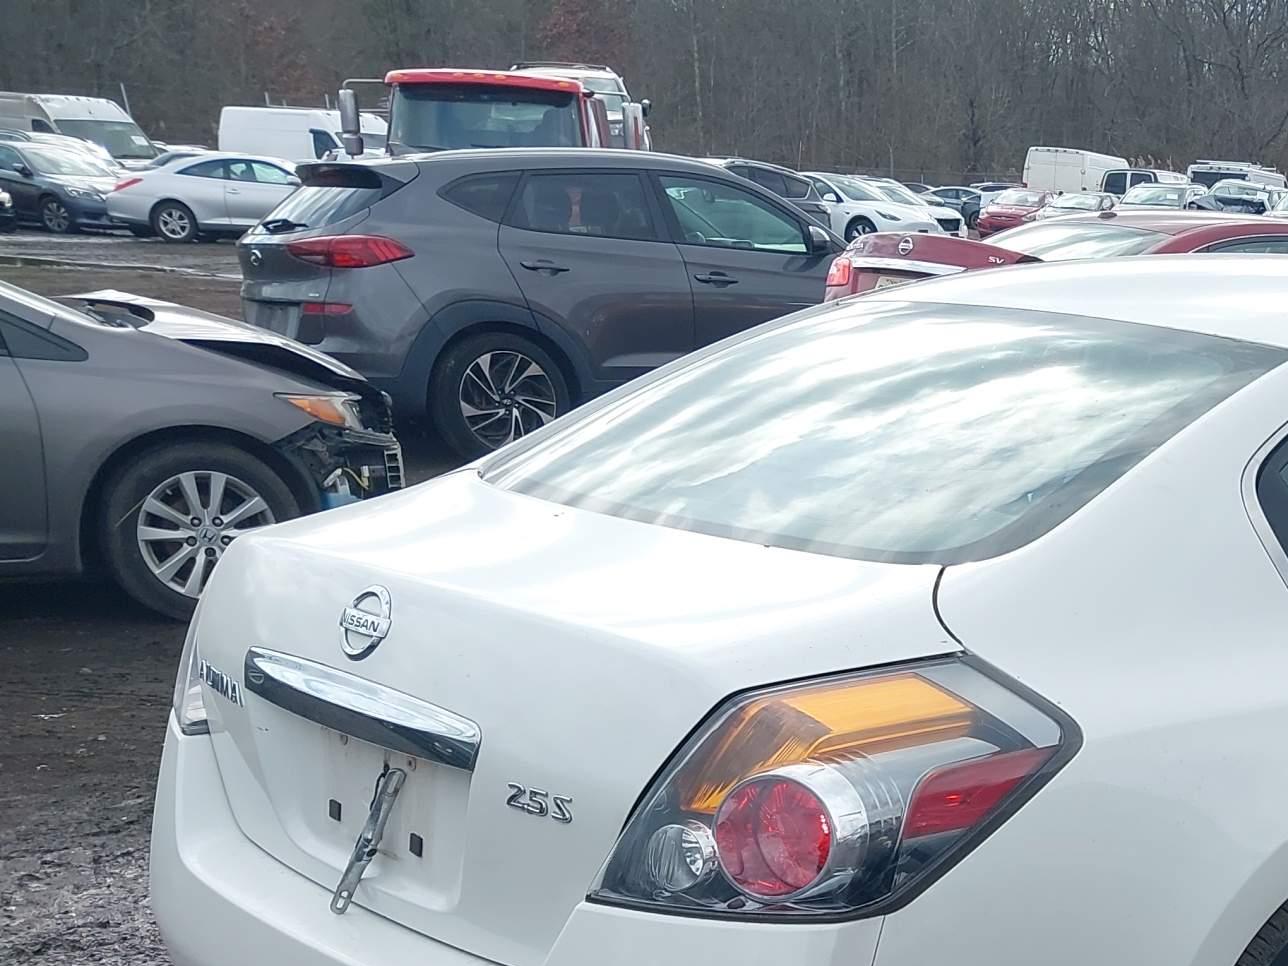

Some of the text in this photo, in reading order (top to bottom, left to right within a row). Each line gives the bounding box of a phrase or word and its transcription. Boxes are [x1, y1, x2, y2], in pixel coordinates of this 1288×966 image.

[987, 255, 1005, 264] SV
[343, 607, 380, 633] NISSAN
[199, 658, 245, 708] ALTIMA
